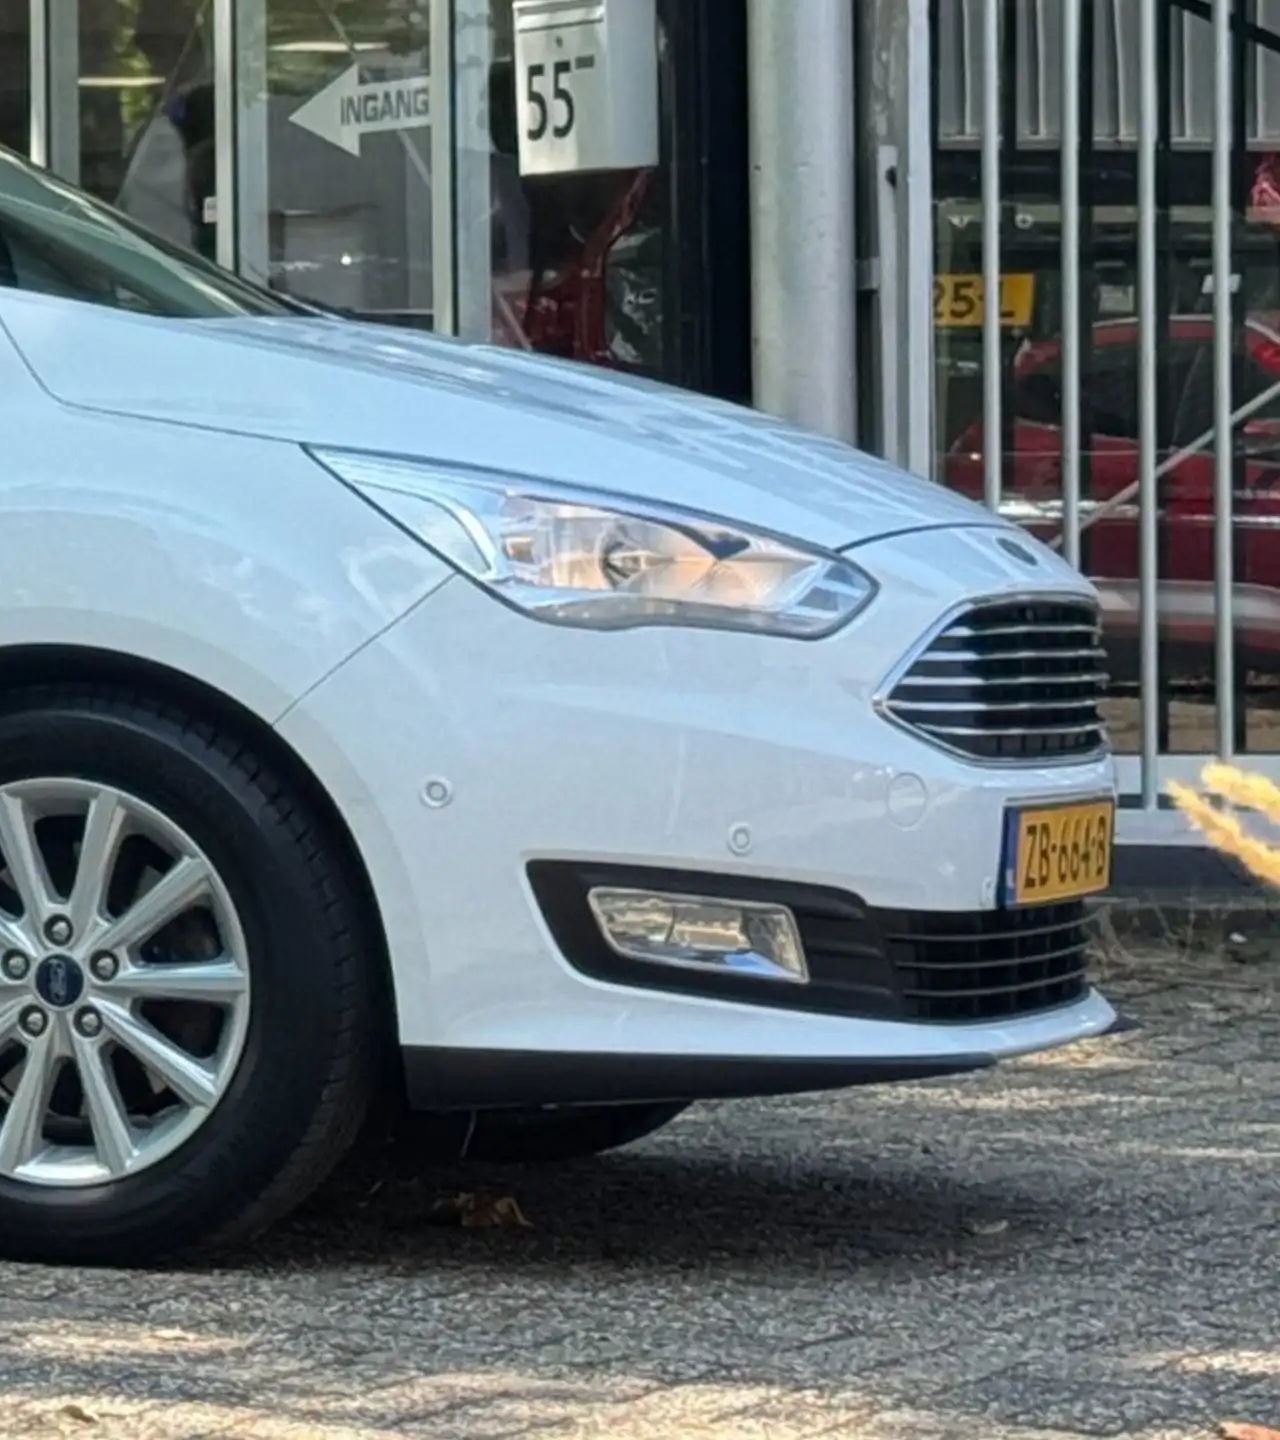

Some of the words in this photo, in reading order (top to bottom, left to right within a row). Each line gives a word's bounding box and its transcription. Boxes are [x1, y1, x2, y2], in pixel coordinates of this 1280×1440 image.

[340, 88, 429, 126] INGANG
[526, 60, 575, 142] 55
[1023, 814, 1108, 889] ZB-664-B
